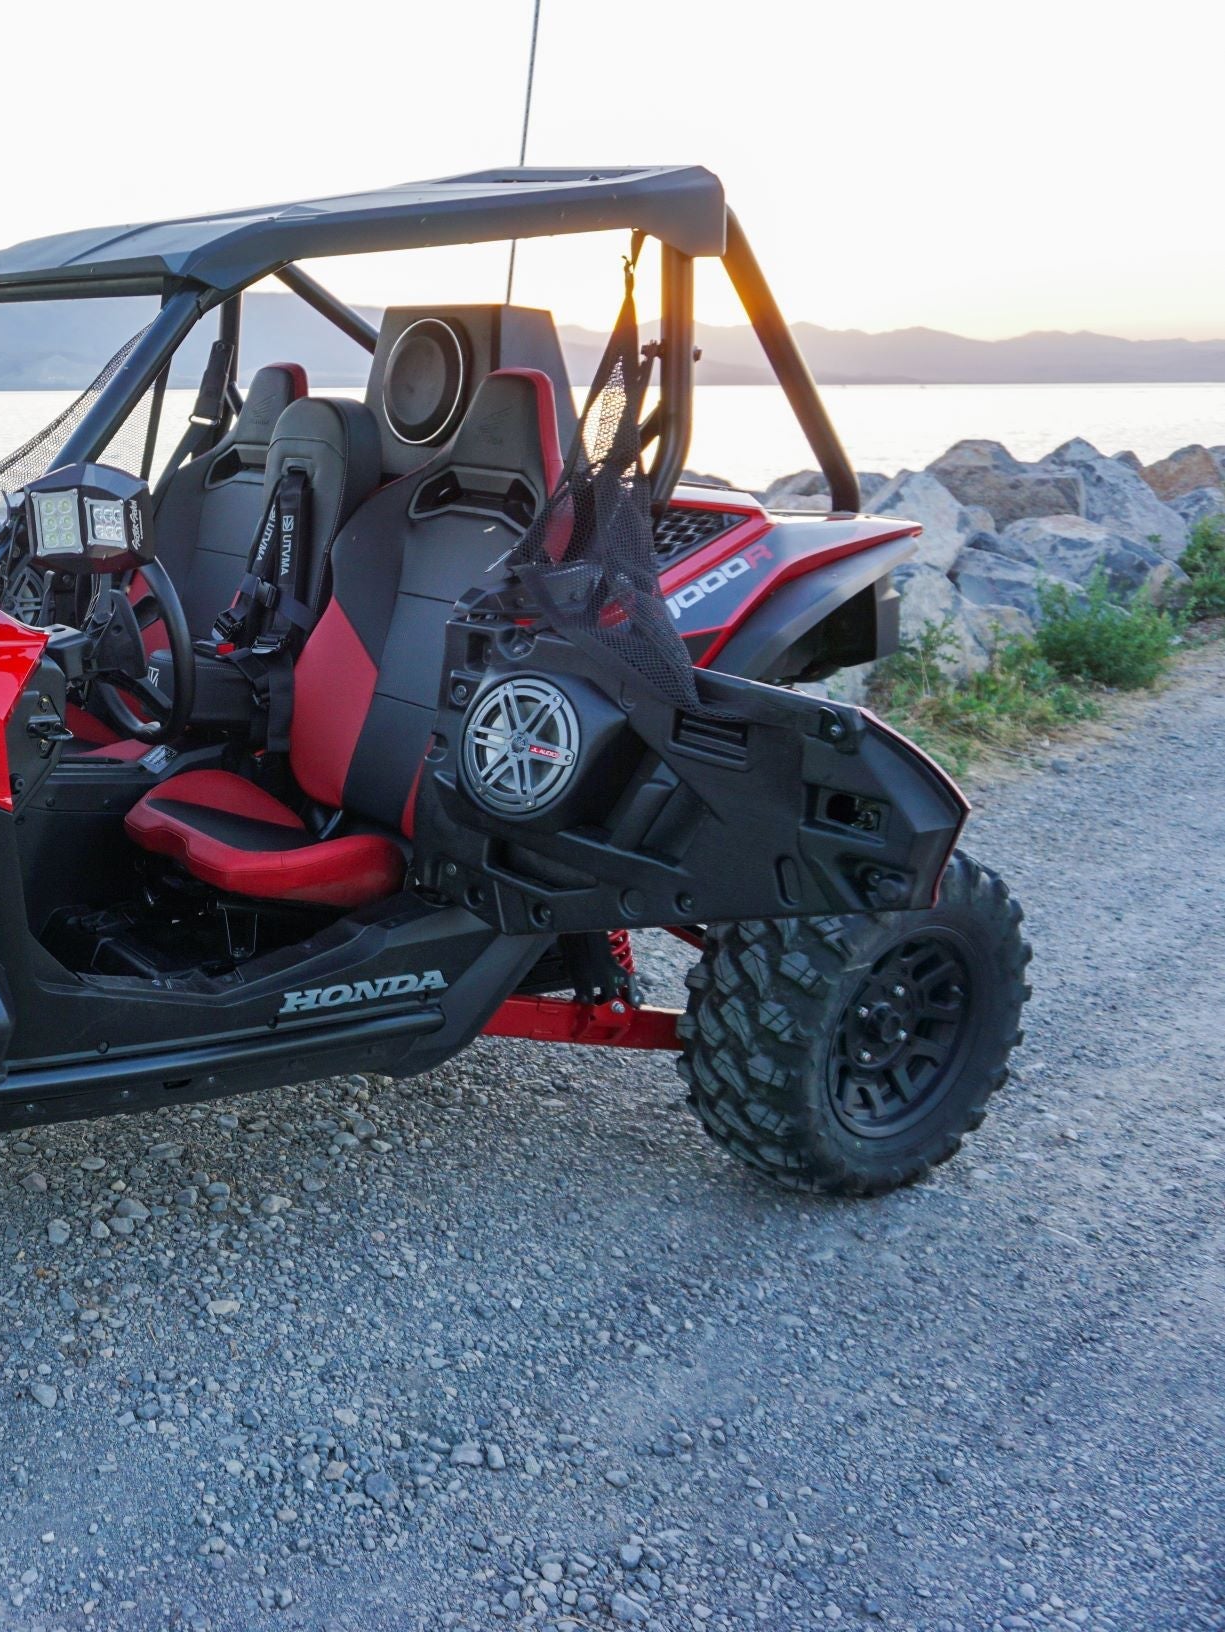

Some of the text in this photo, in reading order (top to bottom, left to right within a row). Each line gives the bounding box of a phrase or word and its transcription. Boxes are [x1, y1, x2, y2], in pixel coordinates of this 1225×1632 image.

[256, 522, 275, 561] UTVMA
[281, 534, 292, 576] UTVMA
[665, 544, 774, 619] 1000R
[539, 749, 560, 759] AUDIO
[279, 970, 448, 1014] HONDA
